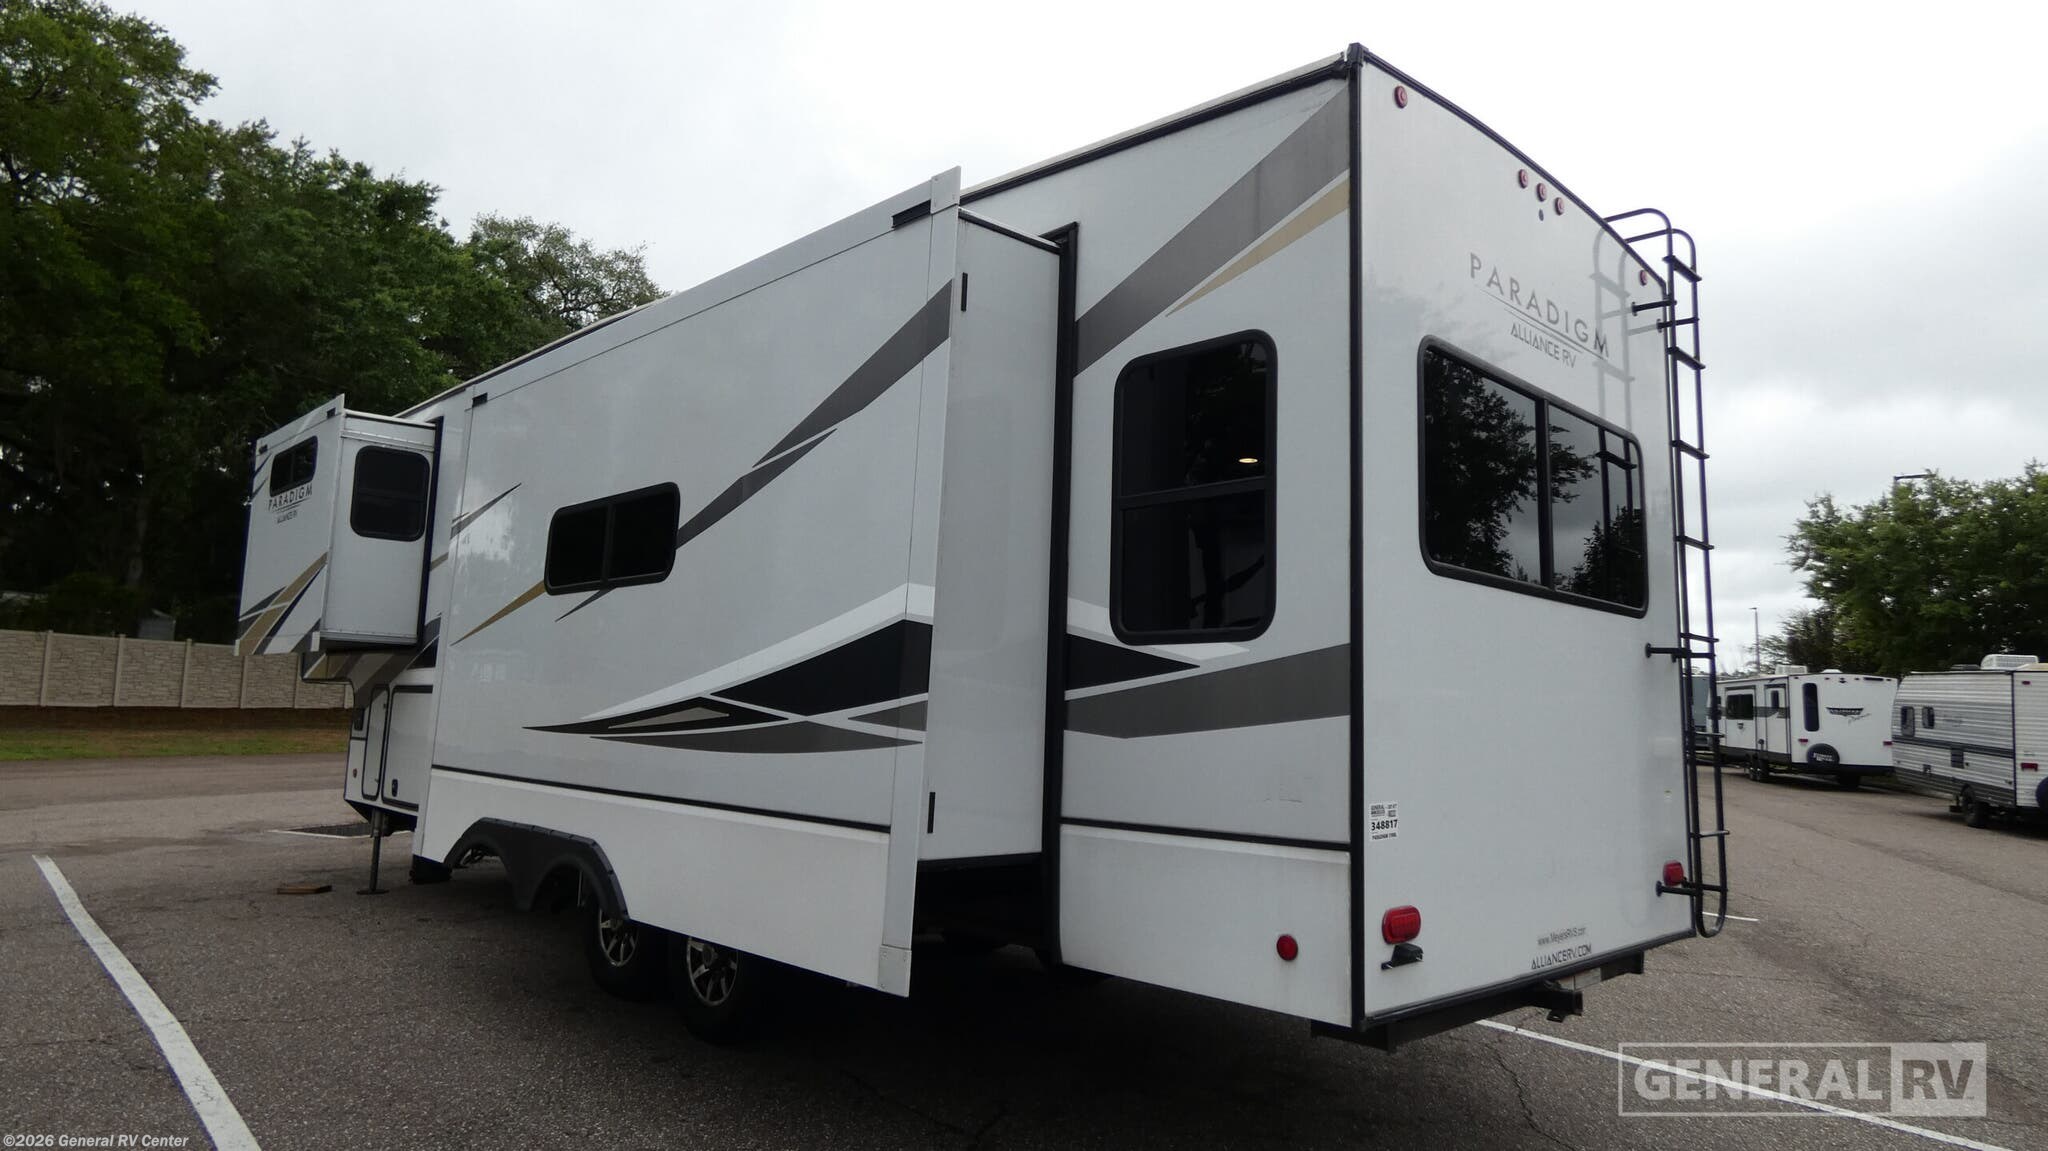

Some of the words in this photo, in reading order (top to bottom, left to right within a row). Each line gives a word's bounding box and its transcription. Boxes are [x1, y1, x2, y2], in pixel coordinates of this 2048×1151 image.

[1469, 252, 1610, 358] PARADIGM
[1510, 322, 1560, 361] ALLIANCE
[1562, 348, 1578, 368] RV
[268, 483, 313, 511] PARADIGM
[1371, 819, 1398, 831] 348817
[1531, 942, 1592, 969] ALLIANCERV.COM
